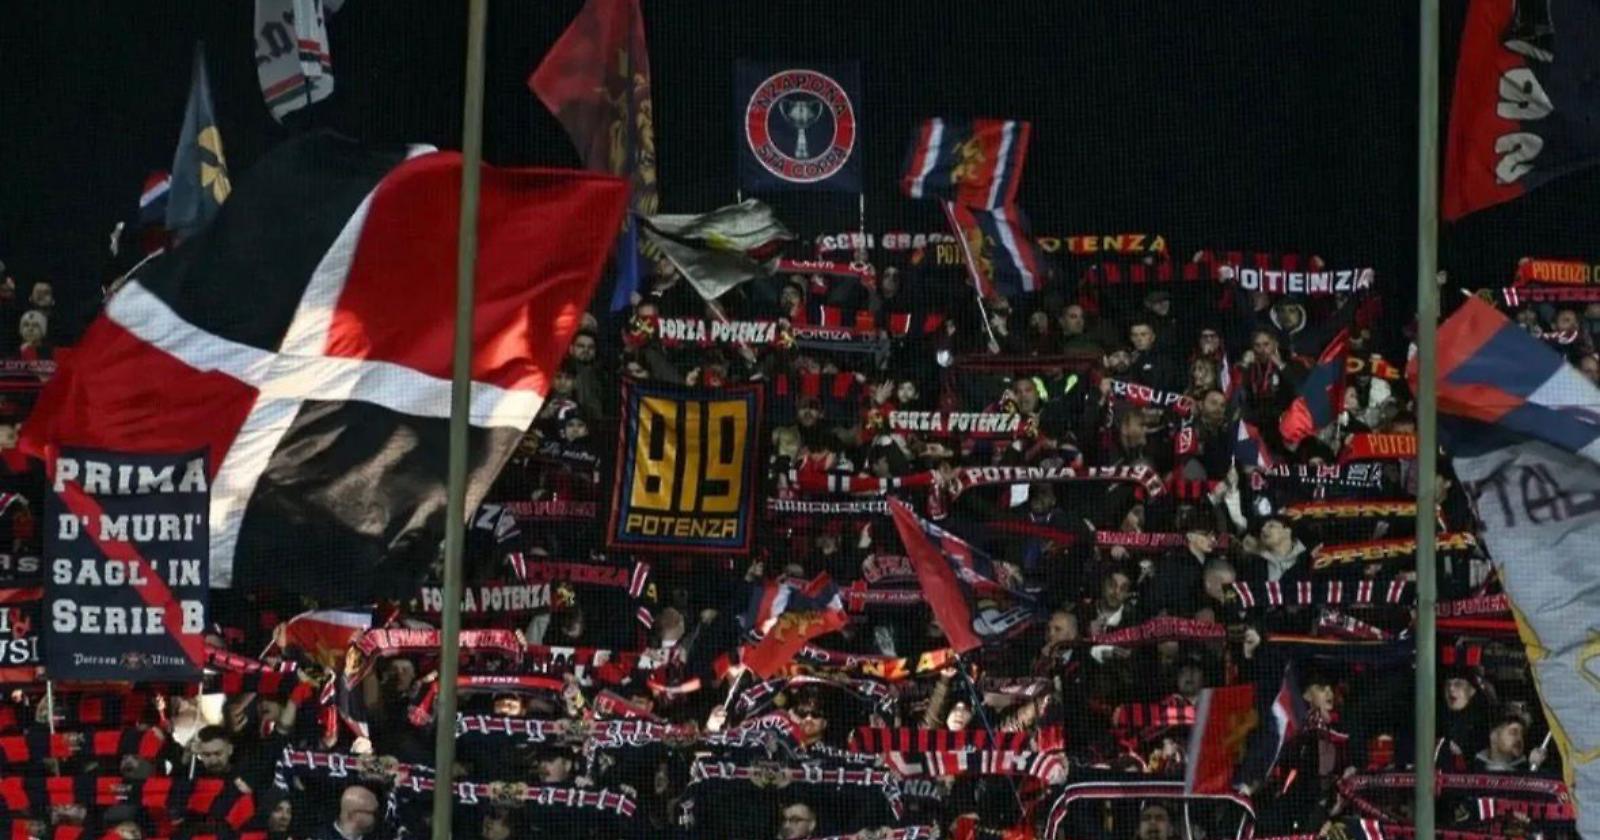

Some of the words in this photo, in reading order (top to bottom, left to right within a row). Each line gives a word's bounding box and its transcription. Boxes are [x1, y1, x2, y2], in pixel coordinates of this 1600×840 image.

[658, 318, 705, 341] FORZA
[711, 319, 776, 343] POTENZA
[888, 411, 943, 431] FORZA
[948, 412, 1021, 432] POTENZA
[631, 397, 747, 512] 819
[53, 458, 207, 493] PRIMA
[966, 465, 1076, 484] POTENZA
[625, 514, 738, 539] POTENZA
[421, 586, 477, 612] FOA
[481, 584, 551, 612] POTENZA
[180, 599, 206, 634] B
